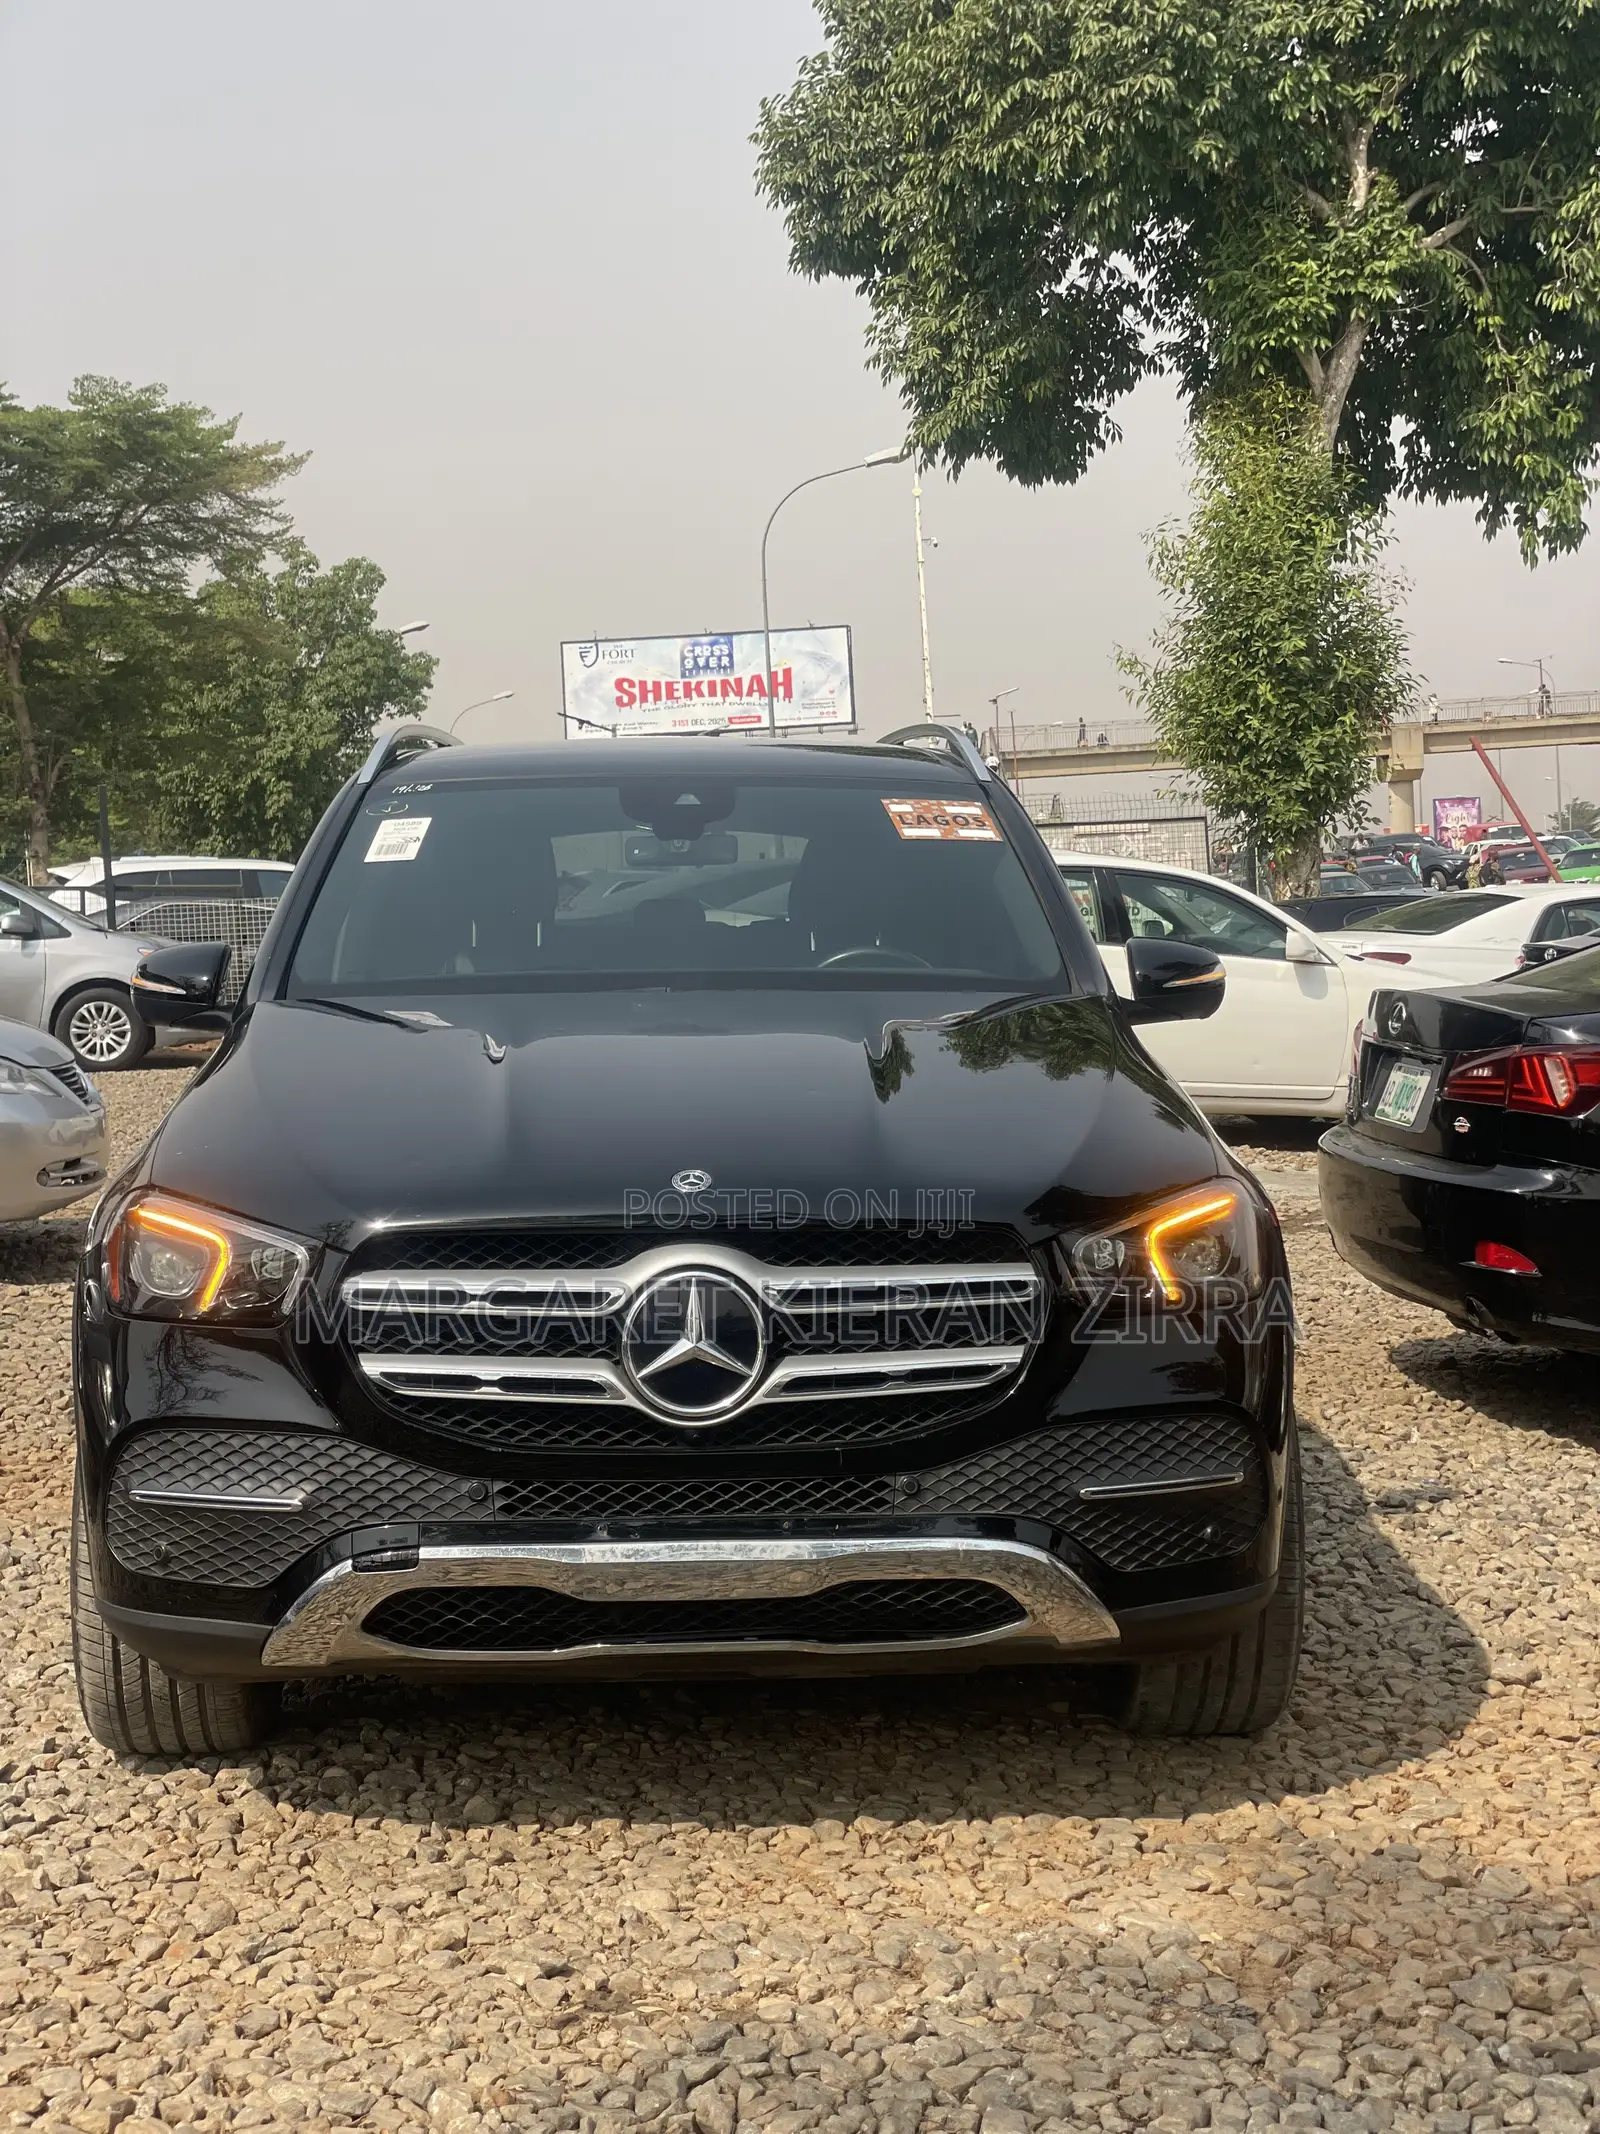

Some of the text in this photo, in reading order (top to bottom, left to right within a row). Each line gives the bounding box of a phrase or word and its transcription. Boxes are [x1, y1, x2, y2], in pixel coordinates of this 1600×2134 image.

[602, 648, 638, 660] FORT
[684, 645, 729, 657] CROSS
[684, 656, 730, 669] OVER
[614, 666, 793, 709] SHEKINAH
[671, 719, 689, 728] 31ST
[898, 814, 987, 828] LAGOS
